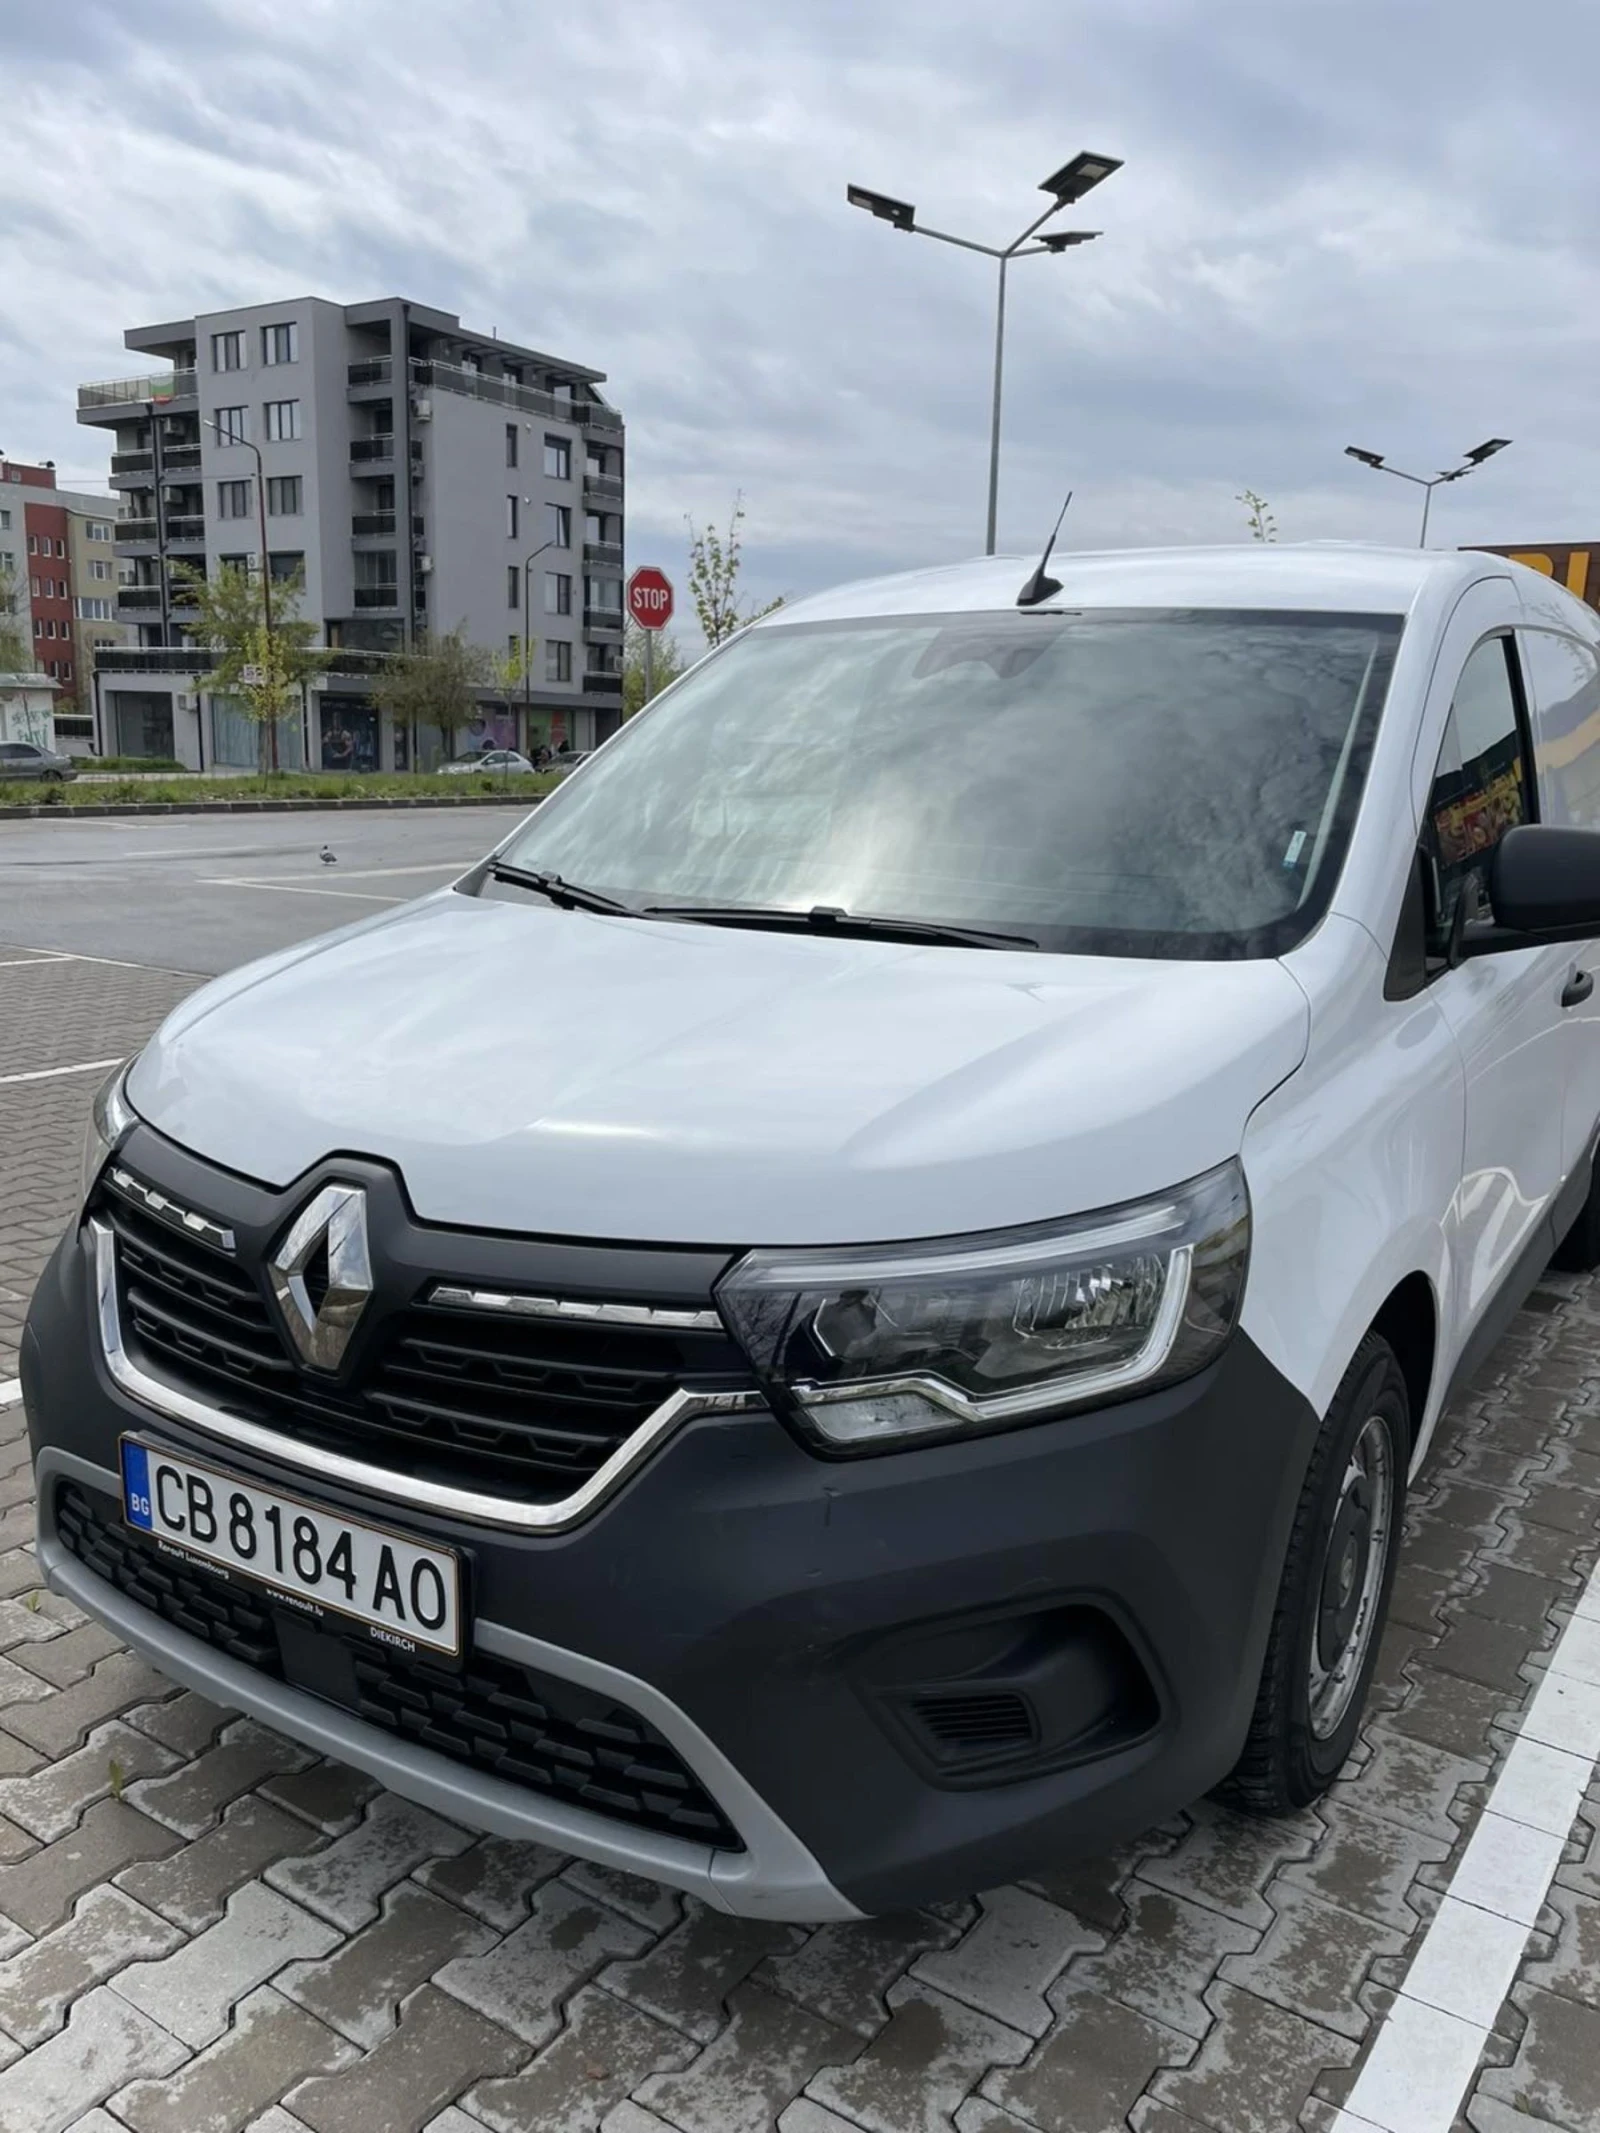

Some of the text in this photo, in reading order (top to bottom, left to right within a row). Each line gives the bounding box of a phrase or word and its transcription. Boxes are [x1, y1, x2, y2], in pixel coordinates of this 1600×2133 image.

[633, 587, 669, 610] STOP
[131, 1493, 149, 1516] BG
[156, 1464, 446, 1631] CB 8184 AO
[265, 1587, 324, 1617] www.renault.lu
[369, 1626, 416, 1653] DIEKIRCH
